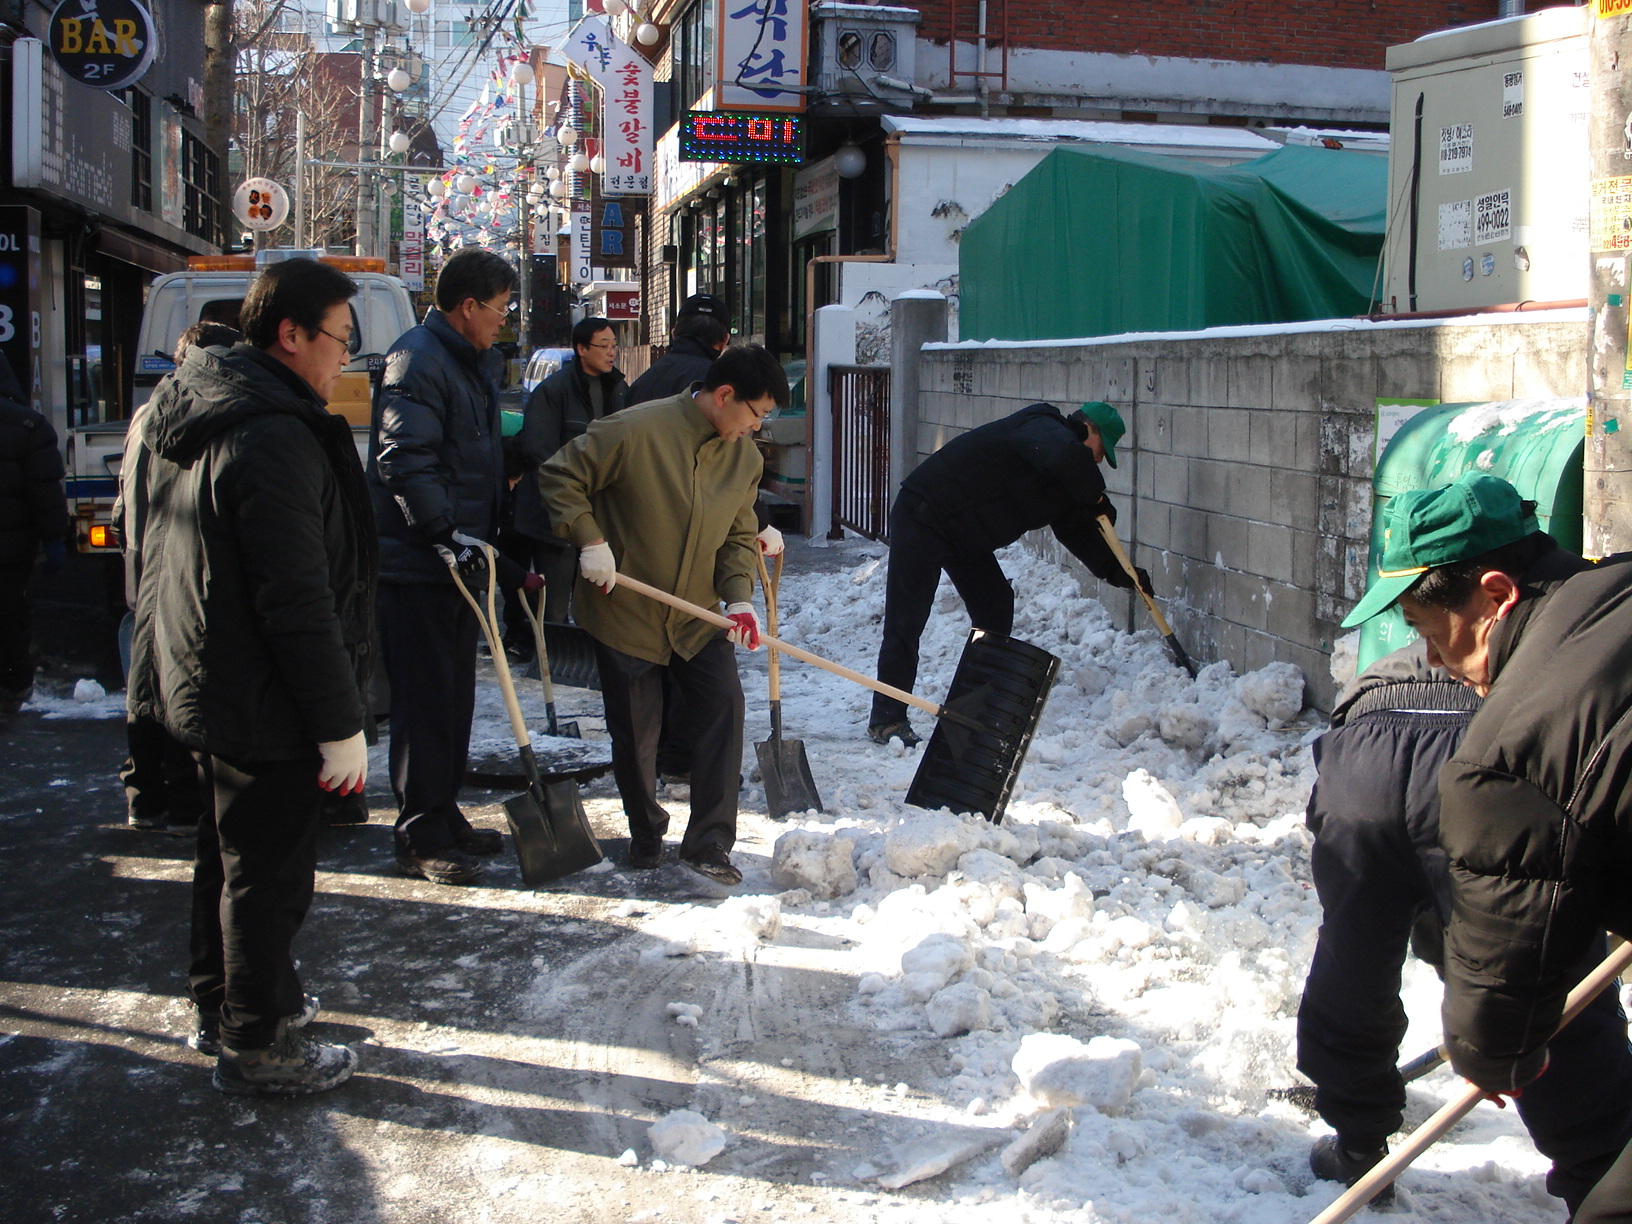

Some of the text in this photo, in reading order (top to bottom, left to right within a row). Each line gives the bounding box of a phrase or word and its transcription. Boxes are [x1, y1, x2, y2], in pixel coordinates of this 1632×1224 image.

[60, 19, 138, 54] BAR
[84, 63, 115, 79] 2F
[615, 61, 647, 174] 숯불갈비
[1477, 207, 1509, 233] 499-0022
